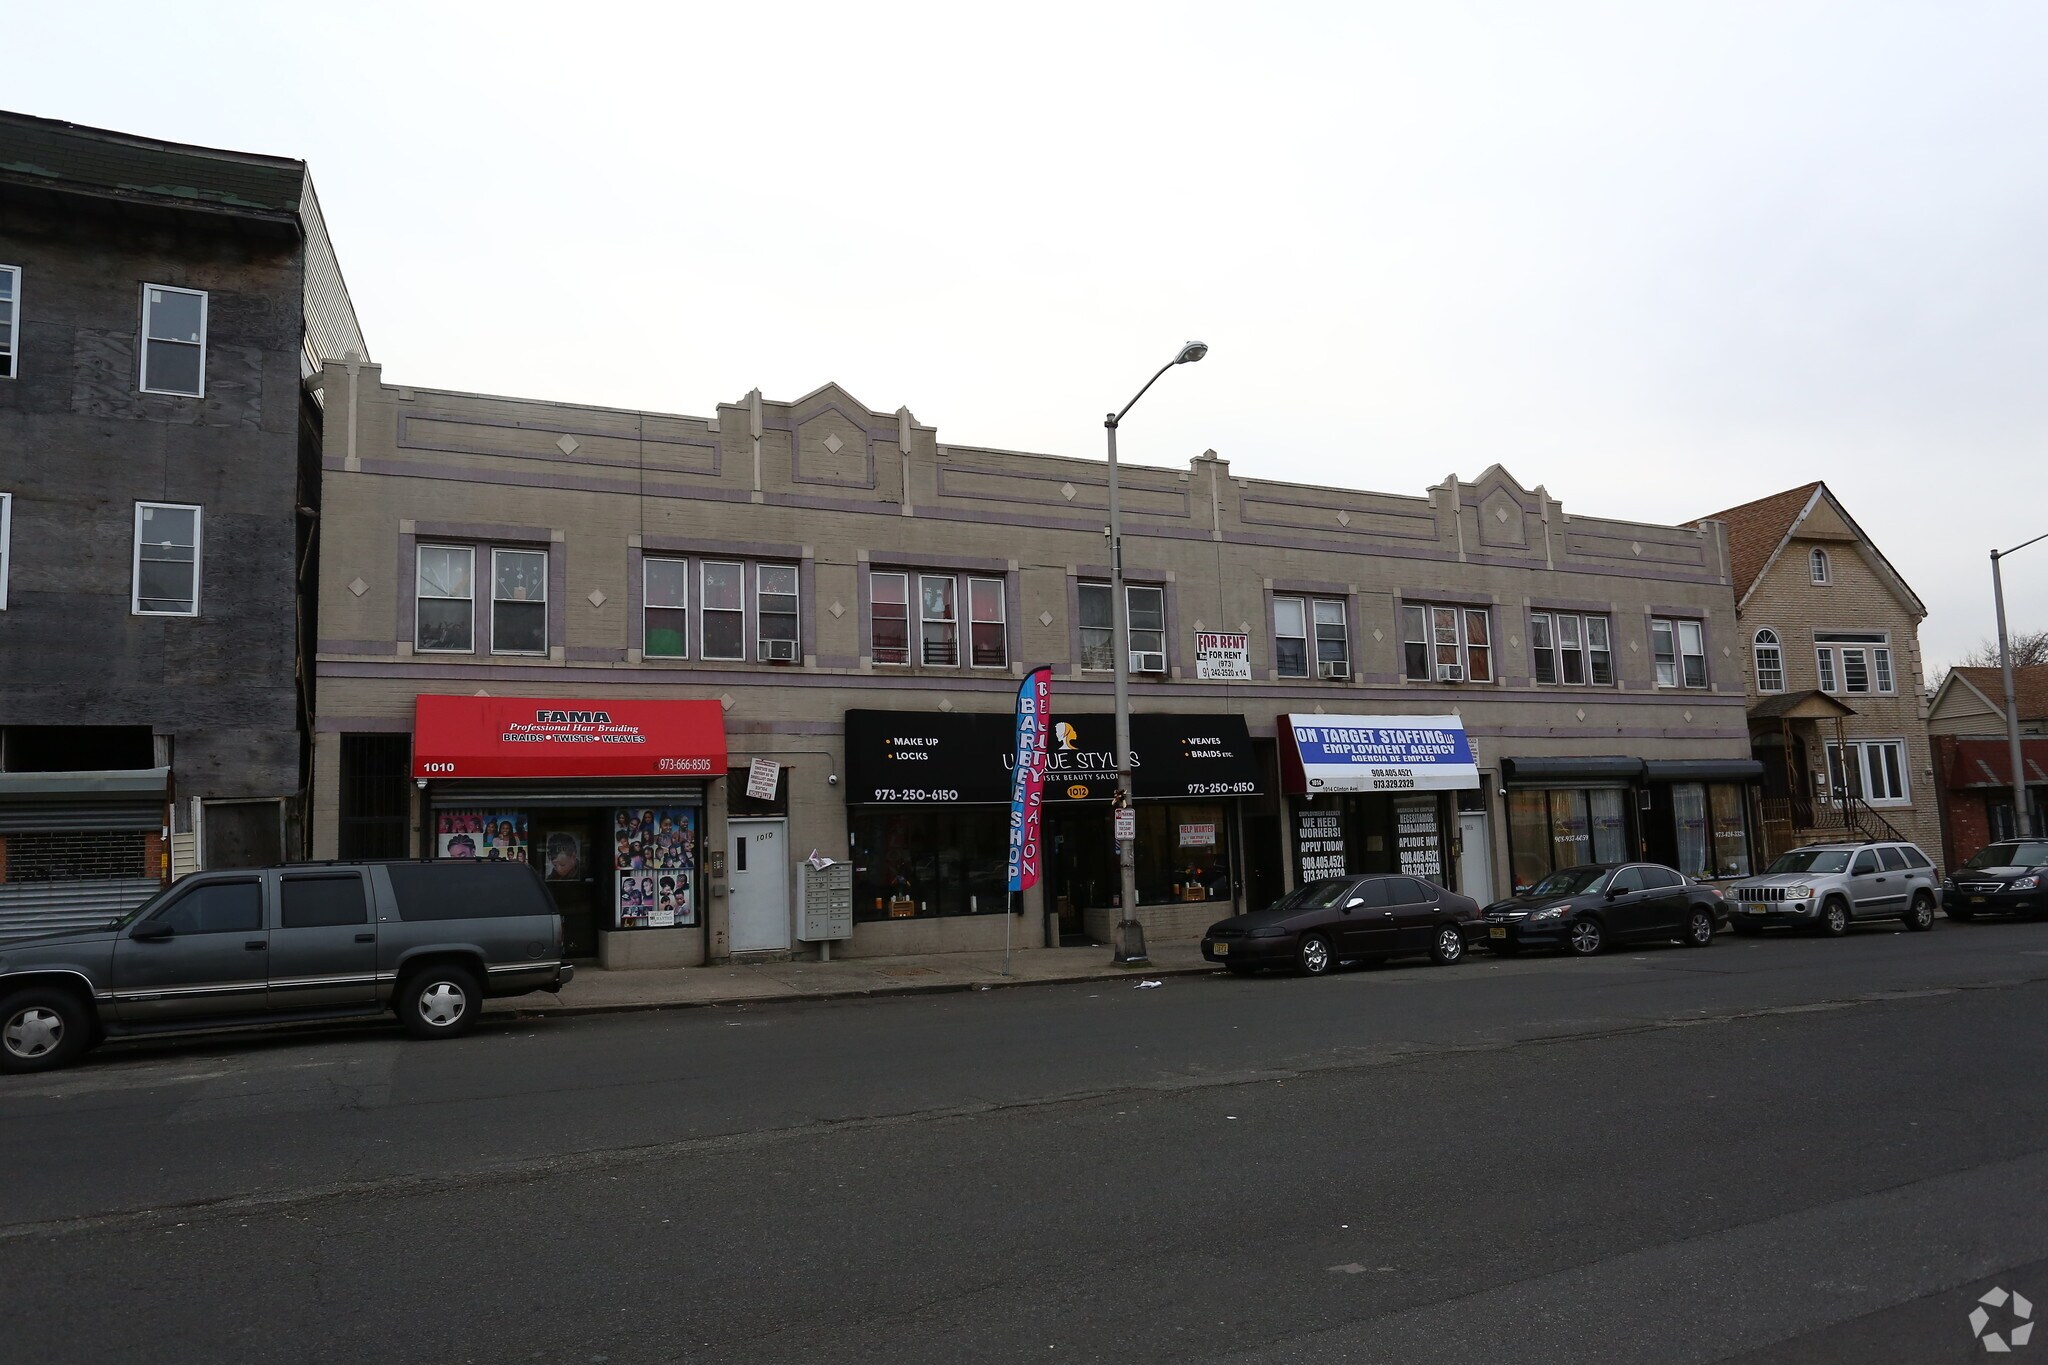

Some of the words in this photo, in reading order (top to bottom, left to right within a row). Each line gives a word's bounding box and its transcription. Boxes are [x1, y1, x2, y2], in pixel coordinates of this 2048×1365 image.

[1198, 635, 1217, 651] FOR
[1220, 636, 1245, 649] RENT
[1209, 651, 1222, 659] FOR
[1211, 669, 1234, 677] 242-2520
[537, 710, 611, 723] FAMA
[509, 723, 570, 732] Professional
[573, 724, 594, 732] Hair
[598, 725, 639, 734] Braiding
[502, 733, 544, 742] BRAIDS
[553, 734, 594, 743] TWISTS
[601, 735, 646, 743] WEAVES
[1296, 728, 1318, 743] ON
[1320, 729, 1373, 743] TARGET
[1380, 730, 1445, 744] STAFFING
[1444, 734, 1454, 744] LLC
[925, 738, 939, 746] UP
[1013, 698, 1035, 802] BARBER
[1323, 744, 1406, 754] EMPLOYMENT
[1410, 745, 1454, 754] AGENCY
[896, 752, 928, 760] LOCKS
[1002, 752, 1071, 771] UUE
[1076, 751, 1141, 769] STYLS
[423, 763, 455, 772] 1010
[660, 759, 711, 770] 973-666-8505
[1371, 769, 1413, 777] 908.405.4521
[1187, 782, 1254, 794] 973-250-6150
[1373, 779, 1414, 789] 973.329.2329
[875, 789, 959, 800] 973-250-6150
[1069, 788, 1086, 796] 1012
[1302, 817, 1315, 827] WE
[1317, 817, 1337, 827] NEED
[1400, 813, 1434, 823] NECESITAMOS
[1194, 825, 1213, 833] WANTED
[1299, 827, 1341, 838] WORKERS!
[1398, 823, 1437, 833] TRABAJADORES!
[757, 832, 773, 842] 1010
[1023, 792, 1040, 876] SALON
[1008, 811, 1022, 882] SHOP
[1301, 841, 1321, 852] APPLY
[1322, 841, 1344, 852] TODAY
[1399, 837, 1425, 847] APLIQUE
[1426, 836, 1438, 846] HOY
[1302, 855, 1344, 869] 908.405.4521
[1400, 850, 1439, 864] 908.405.4521
[1401, 863, 1440, 875] 973.329.2329
